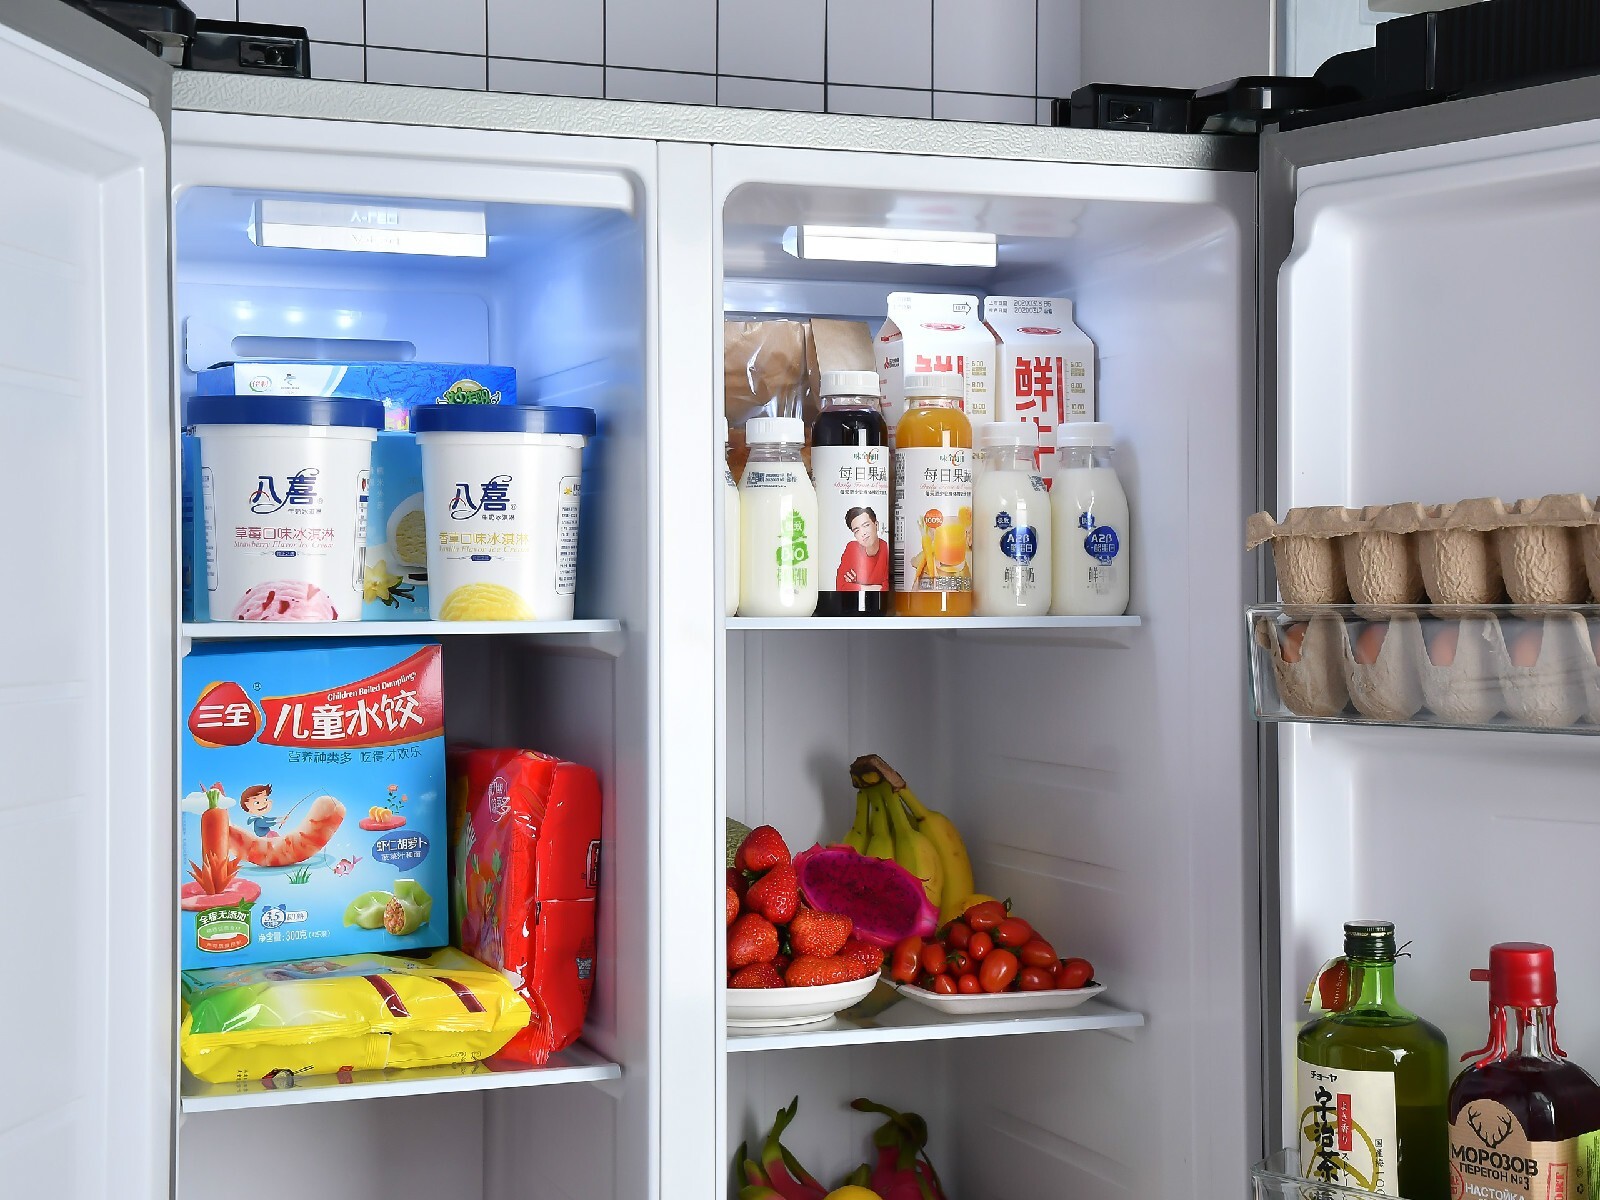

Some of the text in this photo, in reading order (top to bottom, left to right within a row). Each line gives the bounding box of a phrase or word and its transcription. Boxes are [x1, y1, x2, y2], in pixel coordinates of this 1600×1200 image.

[250, 469, 319, 513] 八喜
[449, 475, 512, 519] 八喜
[925, 516, 942, 524] 100%
[235, 527, 334, 540] 草莓口味冰淇淋
[439, 532, 528, 545] 香草口味冰淇淋
[327, 690, 358, 702] Children
[197, 703, 251, 728] 三全
[273, 690, 424, 739] 儿童水饺
[288, 746, 422, 764] 营养种类多 吃得才欢乐
[376, 837, 428, 852] 虾仁胡萝卜
[1311, 1070, 1338, 1083] チョーヤ
[1451, 1143, 1538, 1177] МОРОЗОВ
[1459, 1161, 1508, 1183] ПЕРЕГОН
